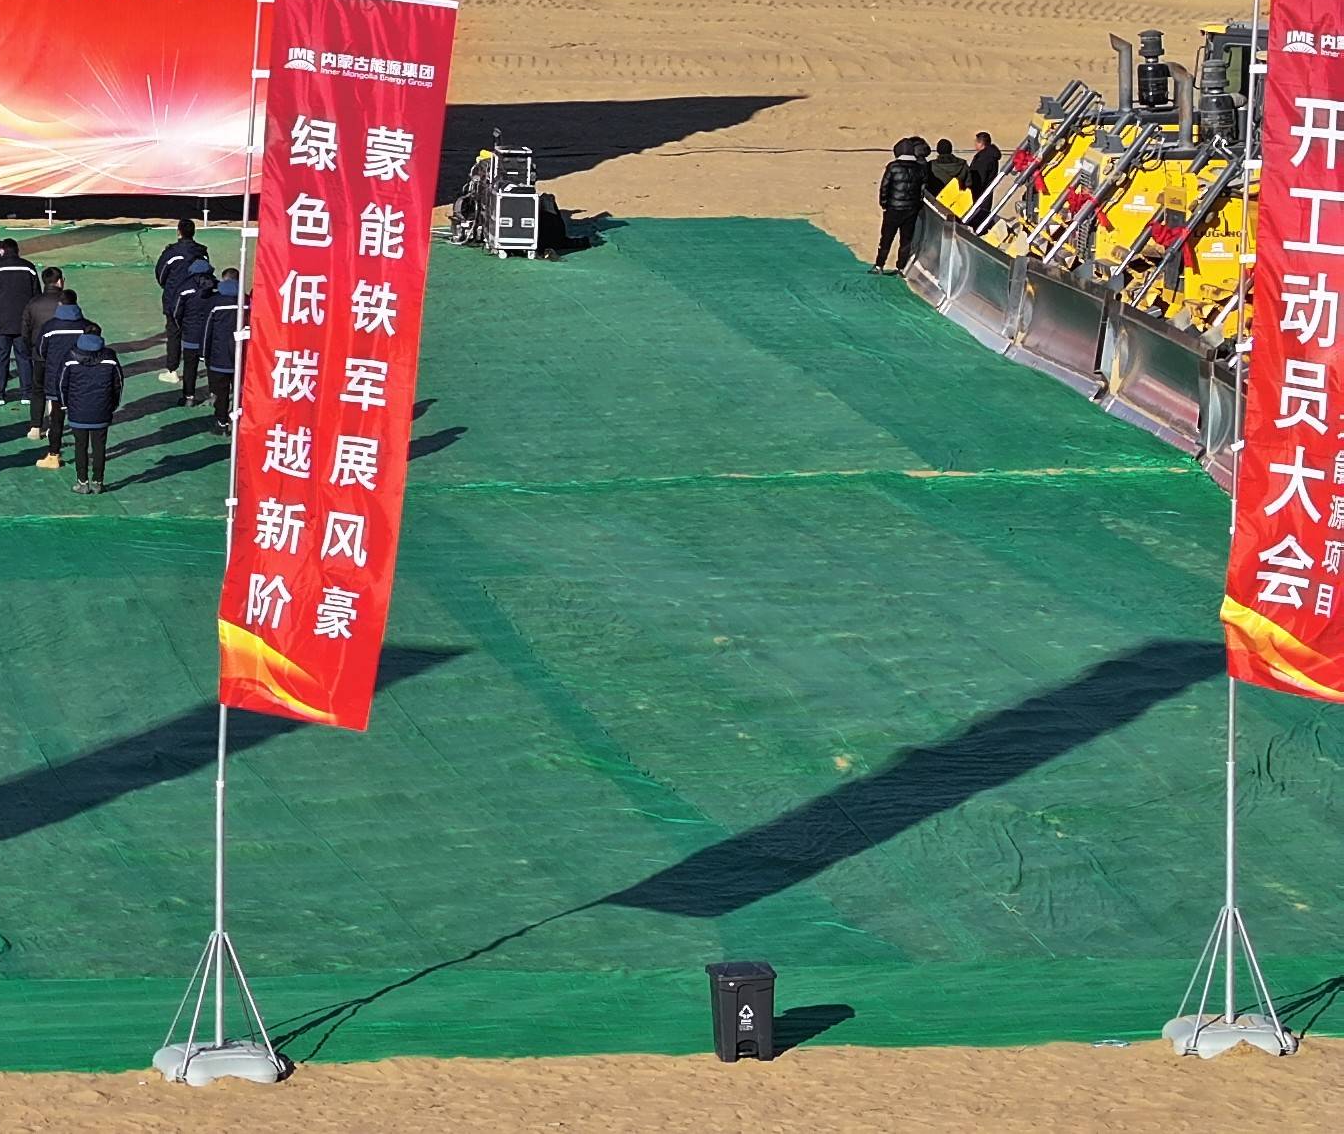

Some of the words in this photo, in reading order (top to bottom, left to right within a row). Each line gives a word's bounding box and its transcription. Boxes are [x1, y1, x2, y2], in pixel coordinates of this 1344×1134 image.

[288, 47, 316, 64] IME
[320, 52, 436, 80] 内蒙古能源集团
[1286, 30, 1315, 46] IME
[244, 114, 338, 630] 绿色低碳越新阶
[313, 125, 414, 640] 蒙能铁军展风豪
[1256, 97, 1344, 610] 开工动员大会
